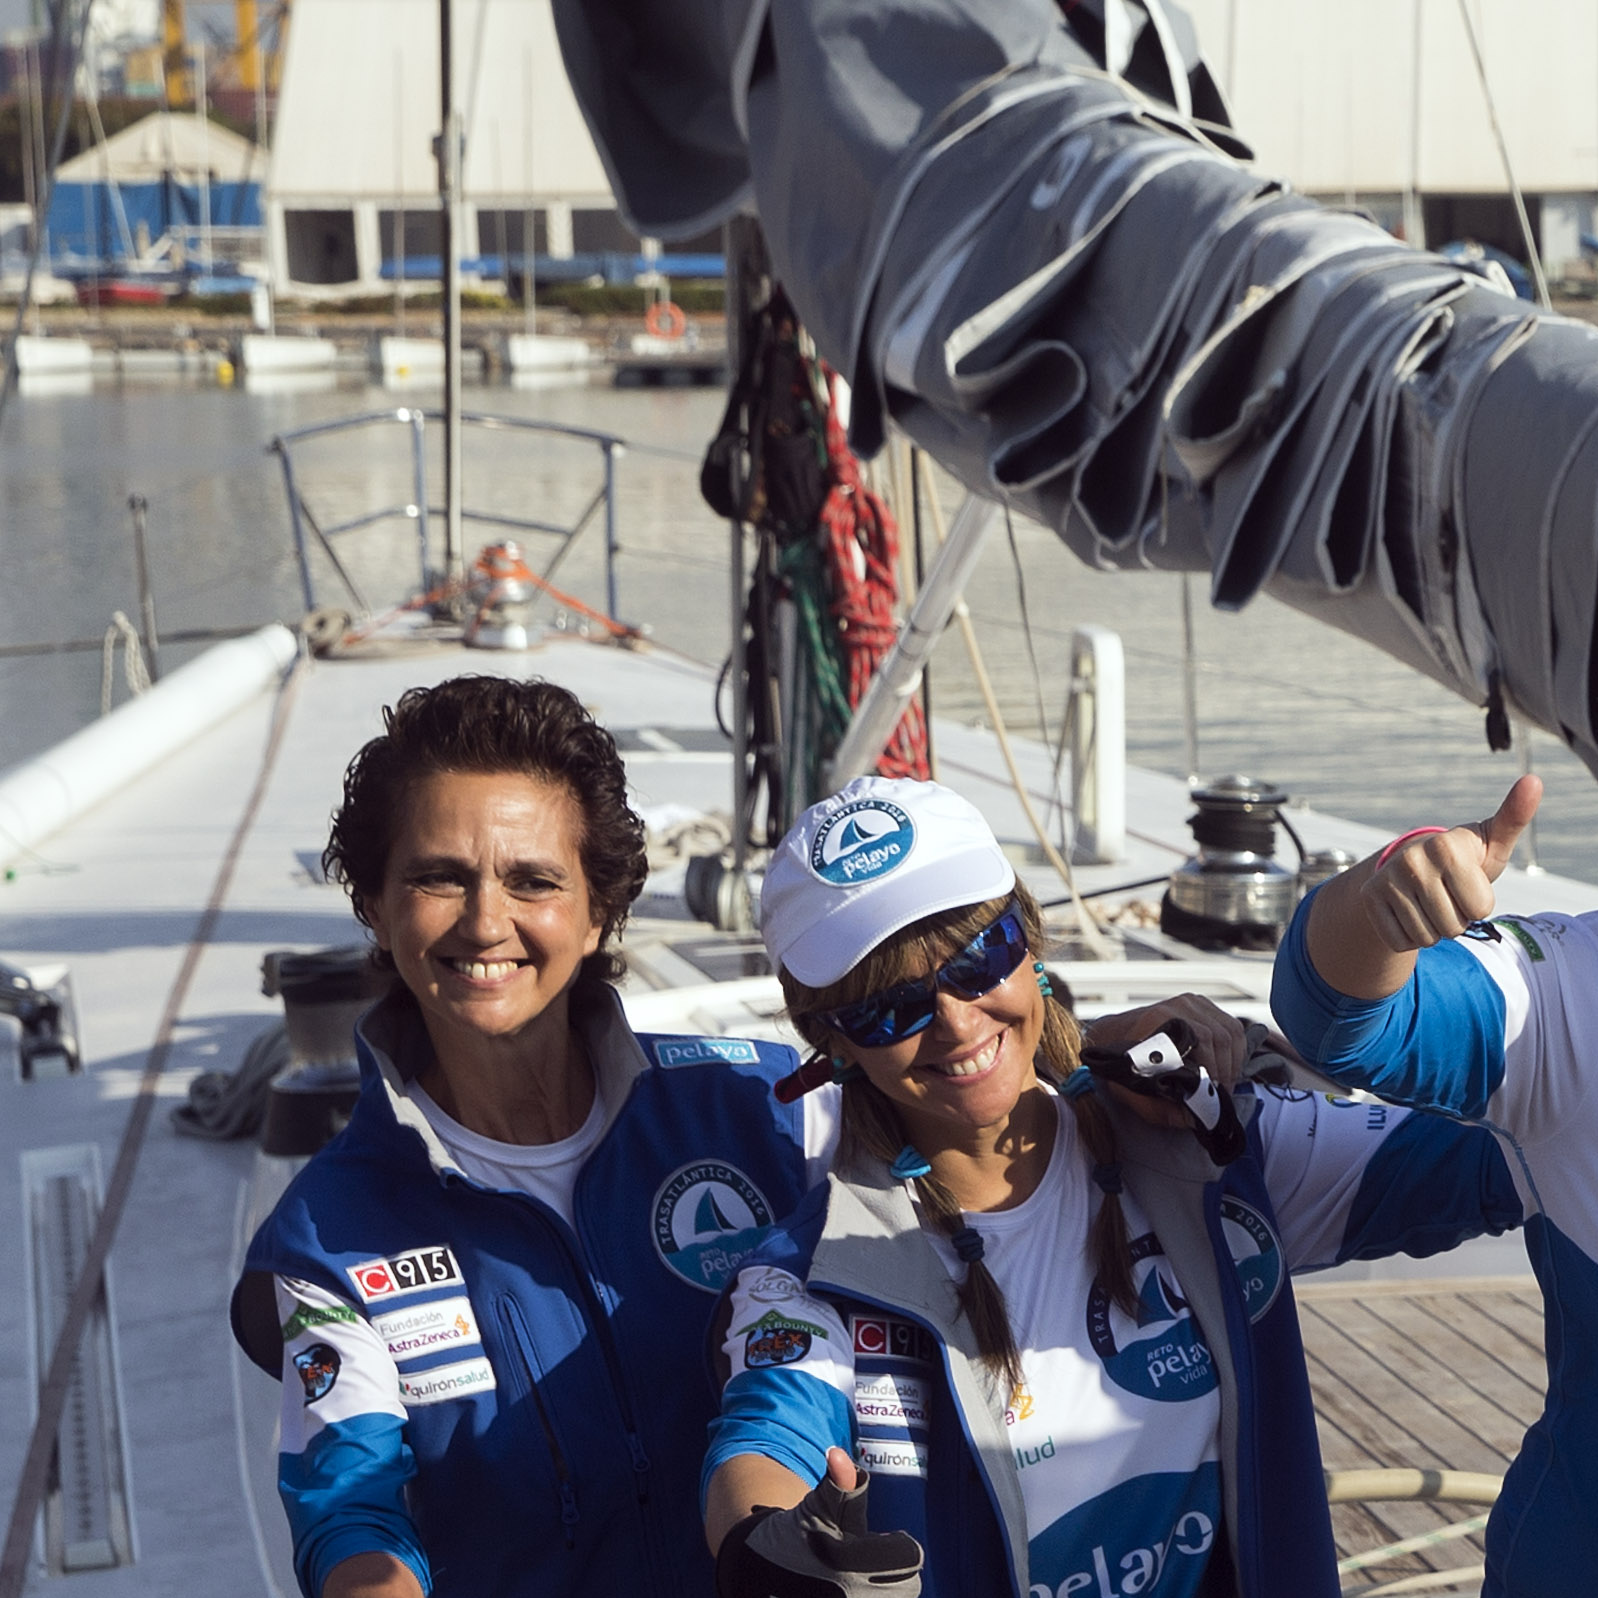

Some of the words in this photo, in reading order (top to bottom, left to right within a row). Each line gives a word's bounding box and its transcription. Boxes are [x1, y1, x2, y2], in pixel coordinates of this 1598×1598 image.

[842, 843, 901, 879] pelayo
[666, 1042, 749, 1065] pelayo
[657, 1166, 733, 1245] TRASATLÁNTICA
[737, 1180, 766, 1216] 2016
[1236, 1210, 1268, 1241] 2016
[361, 1252, 449, 1293] C95
[380, 1311, 444, 1336] Fundación
[773, 1321, 823, 1337] BOUNTY
[388, 1328, 460, 1355] AstraZeneca
[1147, 1343, 1174, 1362] RETO
[1147, 1341, 1212, 1389] pelay
[1179, 1365, 1209, 1385] vida
[409, 1369, 490, 1398] quirónsalud
